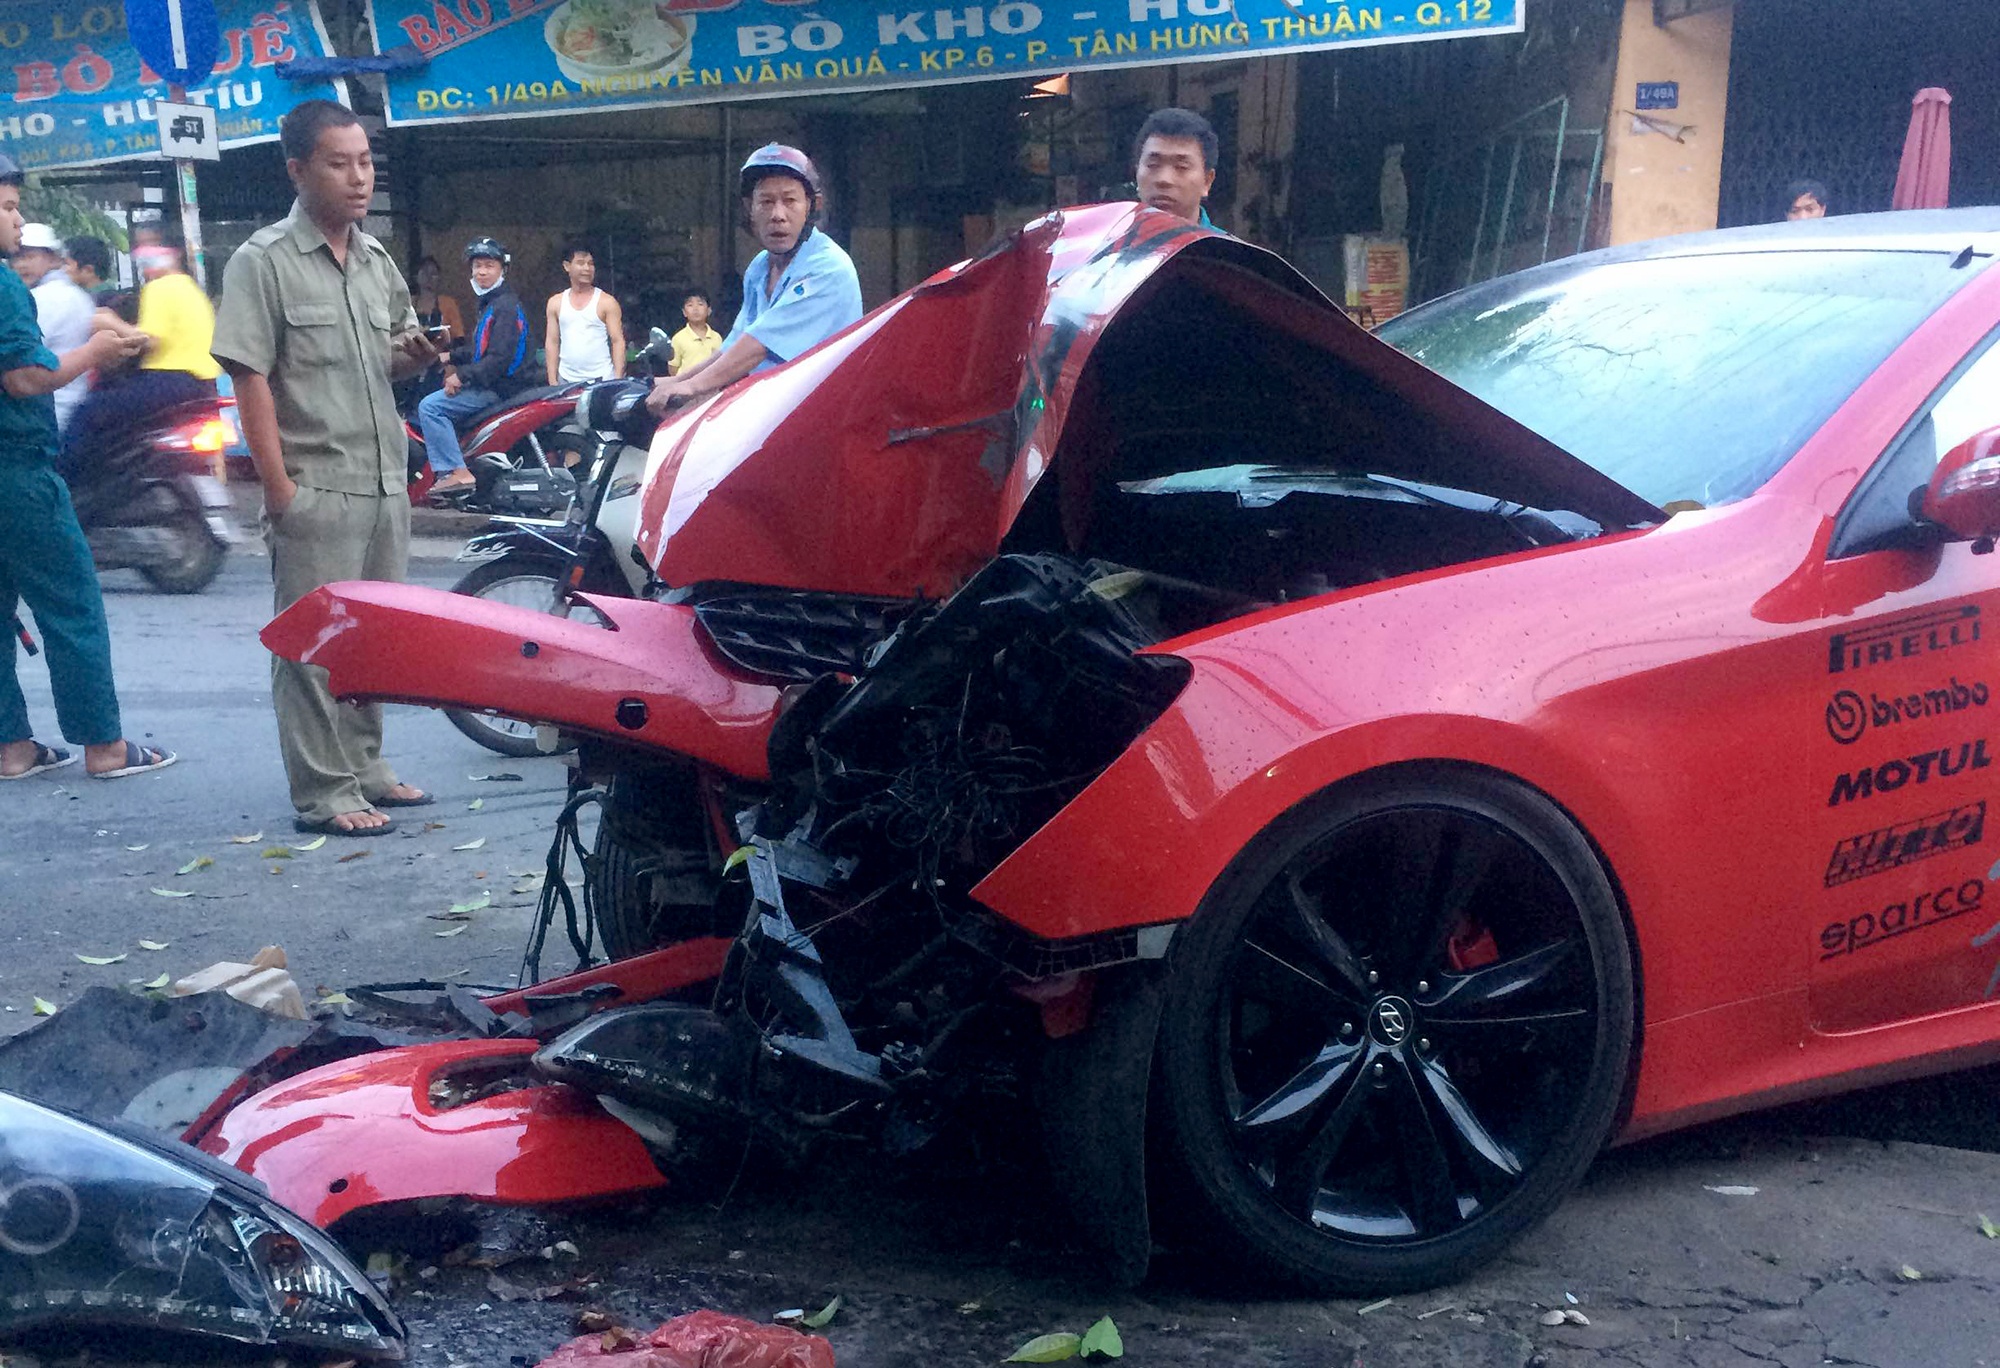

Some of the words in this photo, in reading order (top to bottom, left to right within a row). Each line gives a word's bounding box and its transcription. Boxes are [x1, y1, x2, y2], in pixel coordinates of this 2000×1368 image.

[486, 80, 567, 105] 1/49A
[920, 46, 995, 71] KP.6
[1068, 29, 1137, 58] TÂN
[1260, 6, 1383, 41] THUẬN
[1416, 0, 1492, 26] Q.12
[737, 13, 844, 57] BÒ
[1640, 87, 1675, 100] 1/49A
[184, 120, 199, 134] 5T
[1829, 605, 1981, 674] PIRELLI
[1870, 676, 1990, 728] brembo
[1827, 738, 1992, 807] MOTUL
[1820, 878, 1985, 955] sparco
